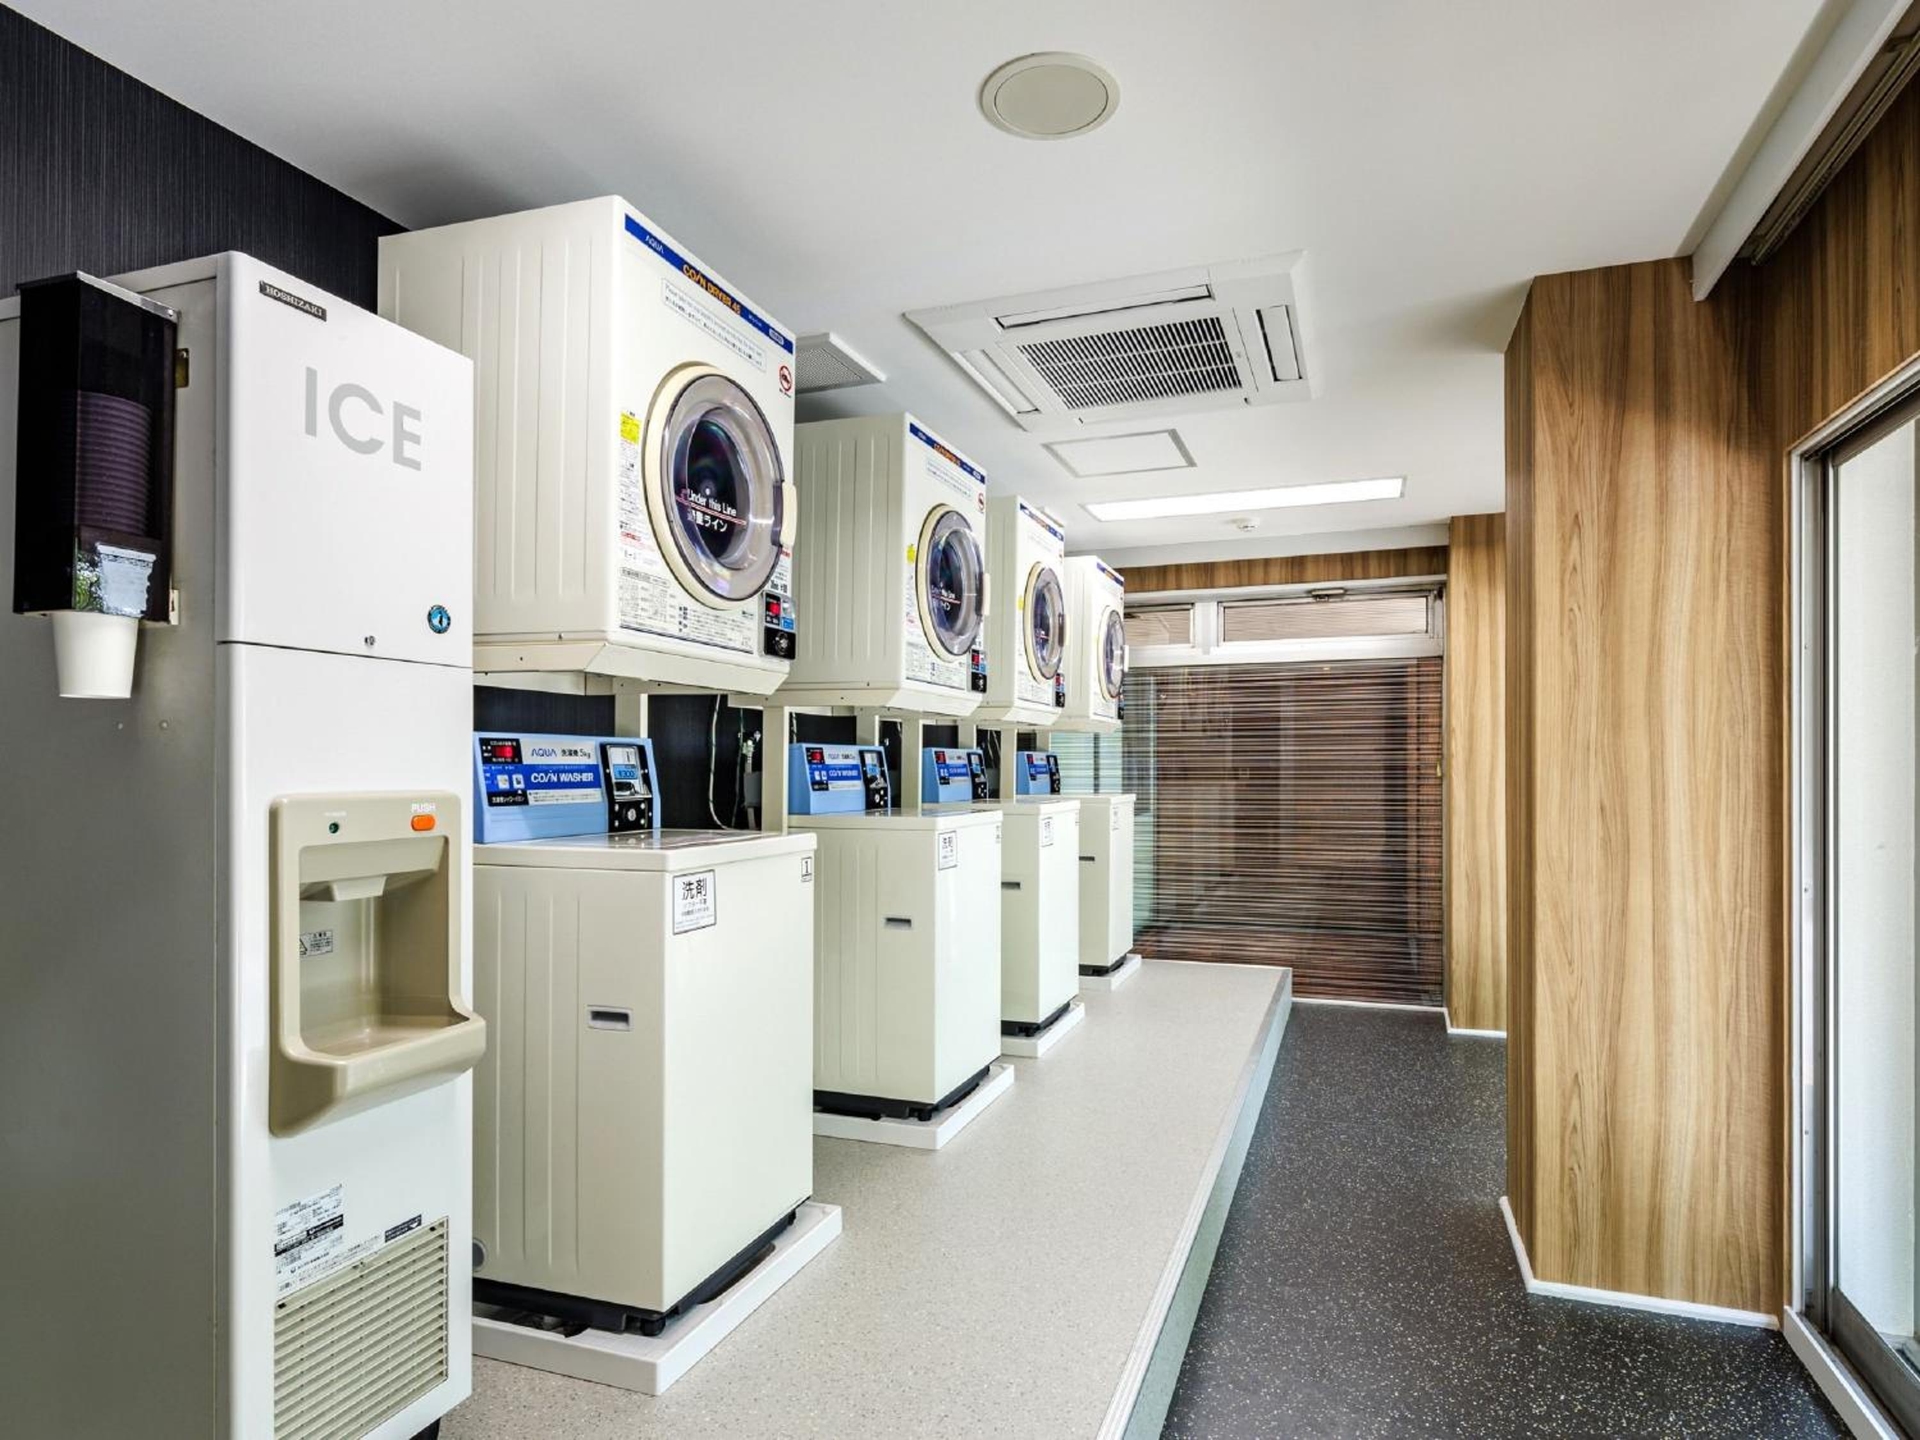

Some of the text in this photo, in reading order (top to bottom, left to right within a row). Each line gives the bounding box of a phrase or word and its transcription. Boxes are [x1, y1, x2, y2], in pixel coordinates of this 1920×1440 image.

[645, 234, 664, 254] AQUA
[265, 285, 323, 316] HOSHIZAKI
[304, 366, 421, 471] ICE
[722, 502, 736, 516] Line
[531, 748, 557, 757] AQUA
[559, 771, 594, 783] WASHER
[411, 802, 436, 813] PUSH
[681, 877, 707, 900] 洗剤
